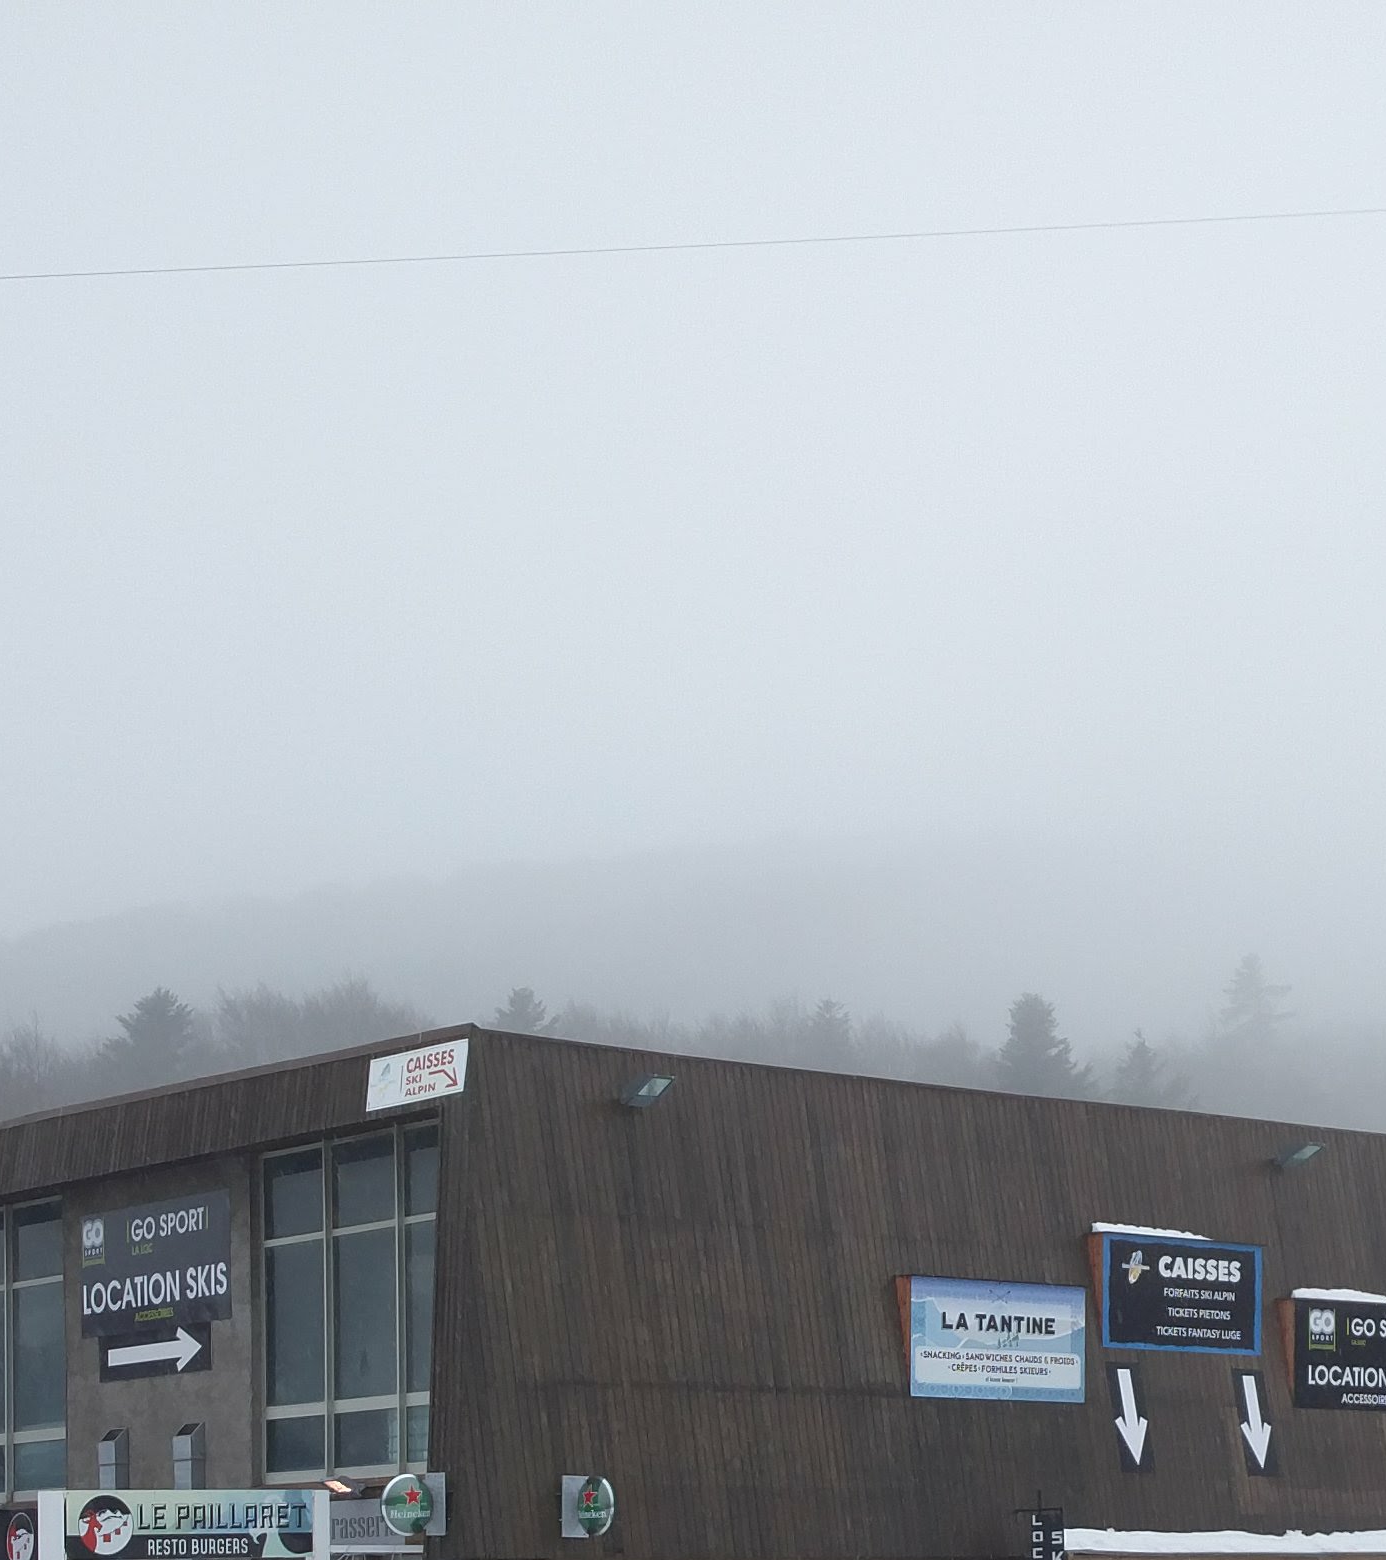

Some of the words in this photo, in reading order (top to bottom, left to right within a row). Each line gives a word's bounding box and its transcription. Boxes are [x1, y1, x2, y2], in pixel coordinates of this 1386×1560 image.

[406, 1049, 455, 1074] CAISSES
[405, 1074, 422, 1086] SKI
[404, 1083, 437, 1097] ALPIN
[131, 1216, 156, 1242] GO
[159, 1207, 205, 1238] SPORT
[1158, 1255, 1242, 1283] CAISSES
[83, 1269, 180, 1315] LOCATION
[186, 1262, 228, 1299] SKIS
[1164, 1287, 1199, 1300] FORFAITS
[1200, 1290, 1213, 1300] SKI
[1213, 1290, 1236, 1302] ALPIN
[942, 1311, 969, 1331] LA
[975, 1313, 1056, 1335] TANTINE
[1168, 1307, 1198, 1319] TICKETS
[1199, 1309, 1231, 1321] PIETONS
[1156, 1325, 1187, 1338] TICKETS
[1188, 1328, 1221, 1340] FANTASY
[1222, 1330, 1242, 1341] LUGE
[1351, 1318, 1376, 1337] GO
[923, 1350, 961, 1361] SNACKING
[965, 1352, 1013, 1363] SANDWICHES
[1014, 1356, 1042, 1364] CHAUDS
[951, 1361, 978, 1373] CRÊPES
[981, 1364, 1018, 1375] FORMULES
[137, 1502, 167, 1530] LE
[175, 1502, 307, 1530] PAILLARET
[148, 1538, 187, 1556] RESTO
[191, 1537, 249, 1555] BURGERS
